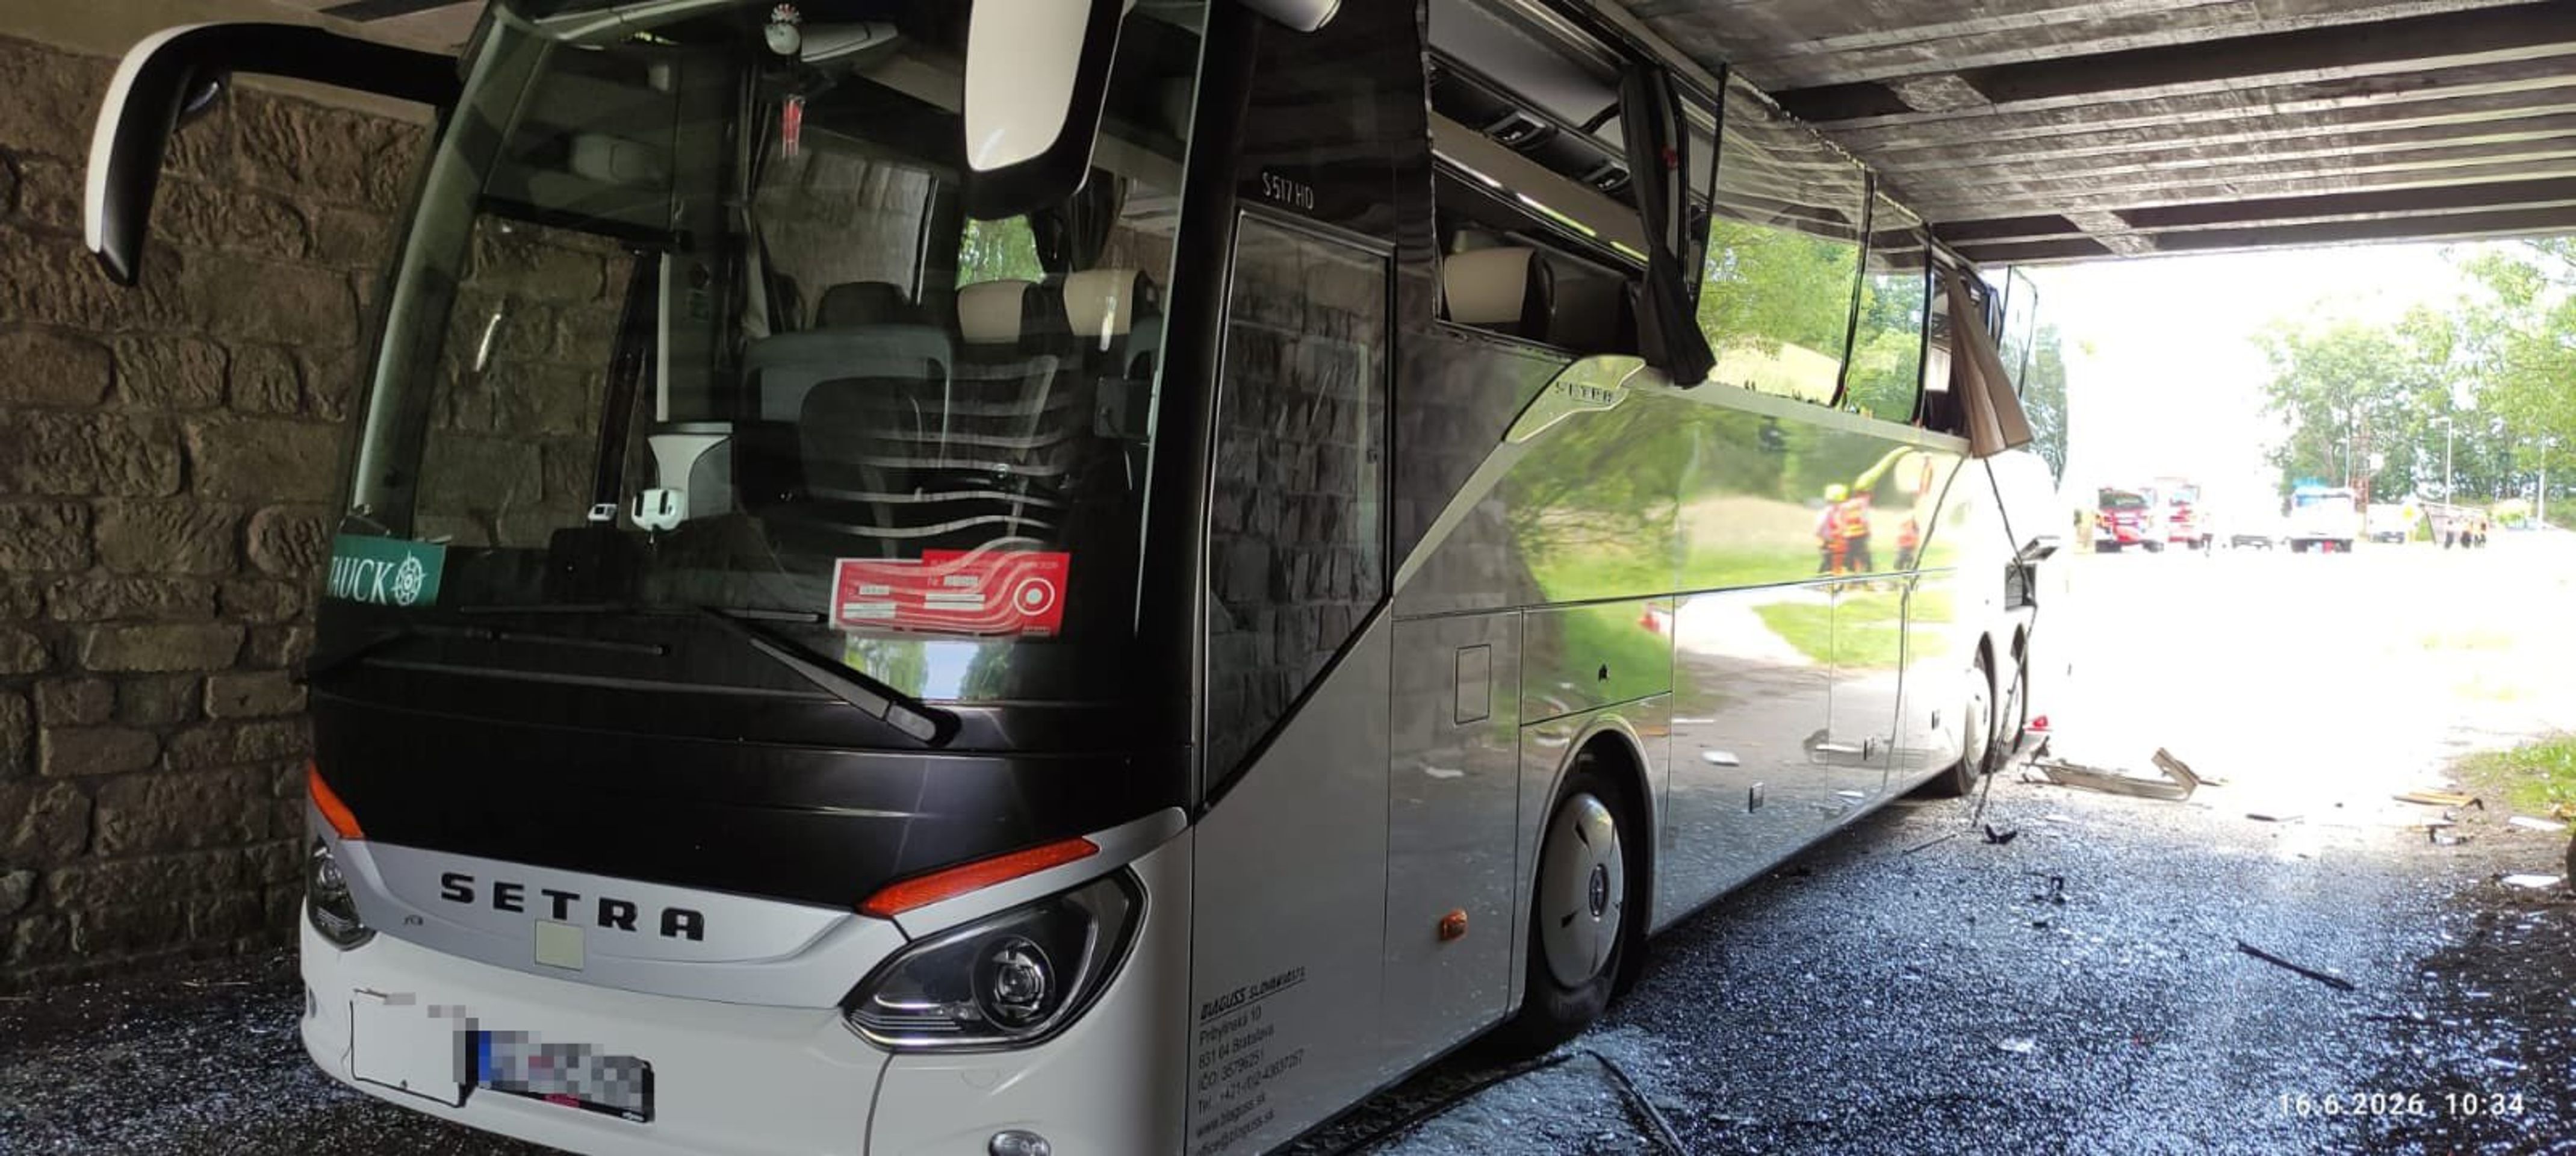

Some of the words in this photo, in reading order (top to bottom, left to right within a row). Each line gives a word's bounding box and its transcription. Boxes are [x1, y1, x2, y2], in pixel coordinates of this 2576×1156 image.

[441, 872, 704, 941] SETRA
[1251, 1005, 1262, 1021] 10
[1198, 1048, 1216, 1069] 831
[1218, 1043, 1229, 1060] 04
